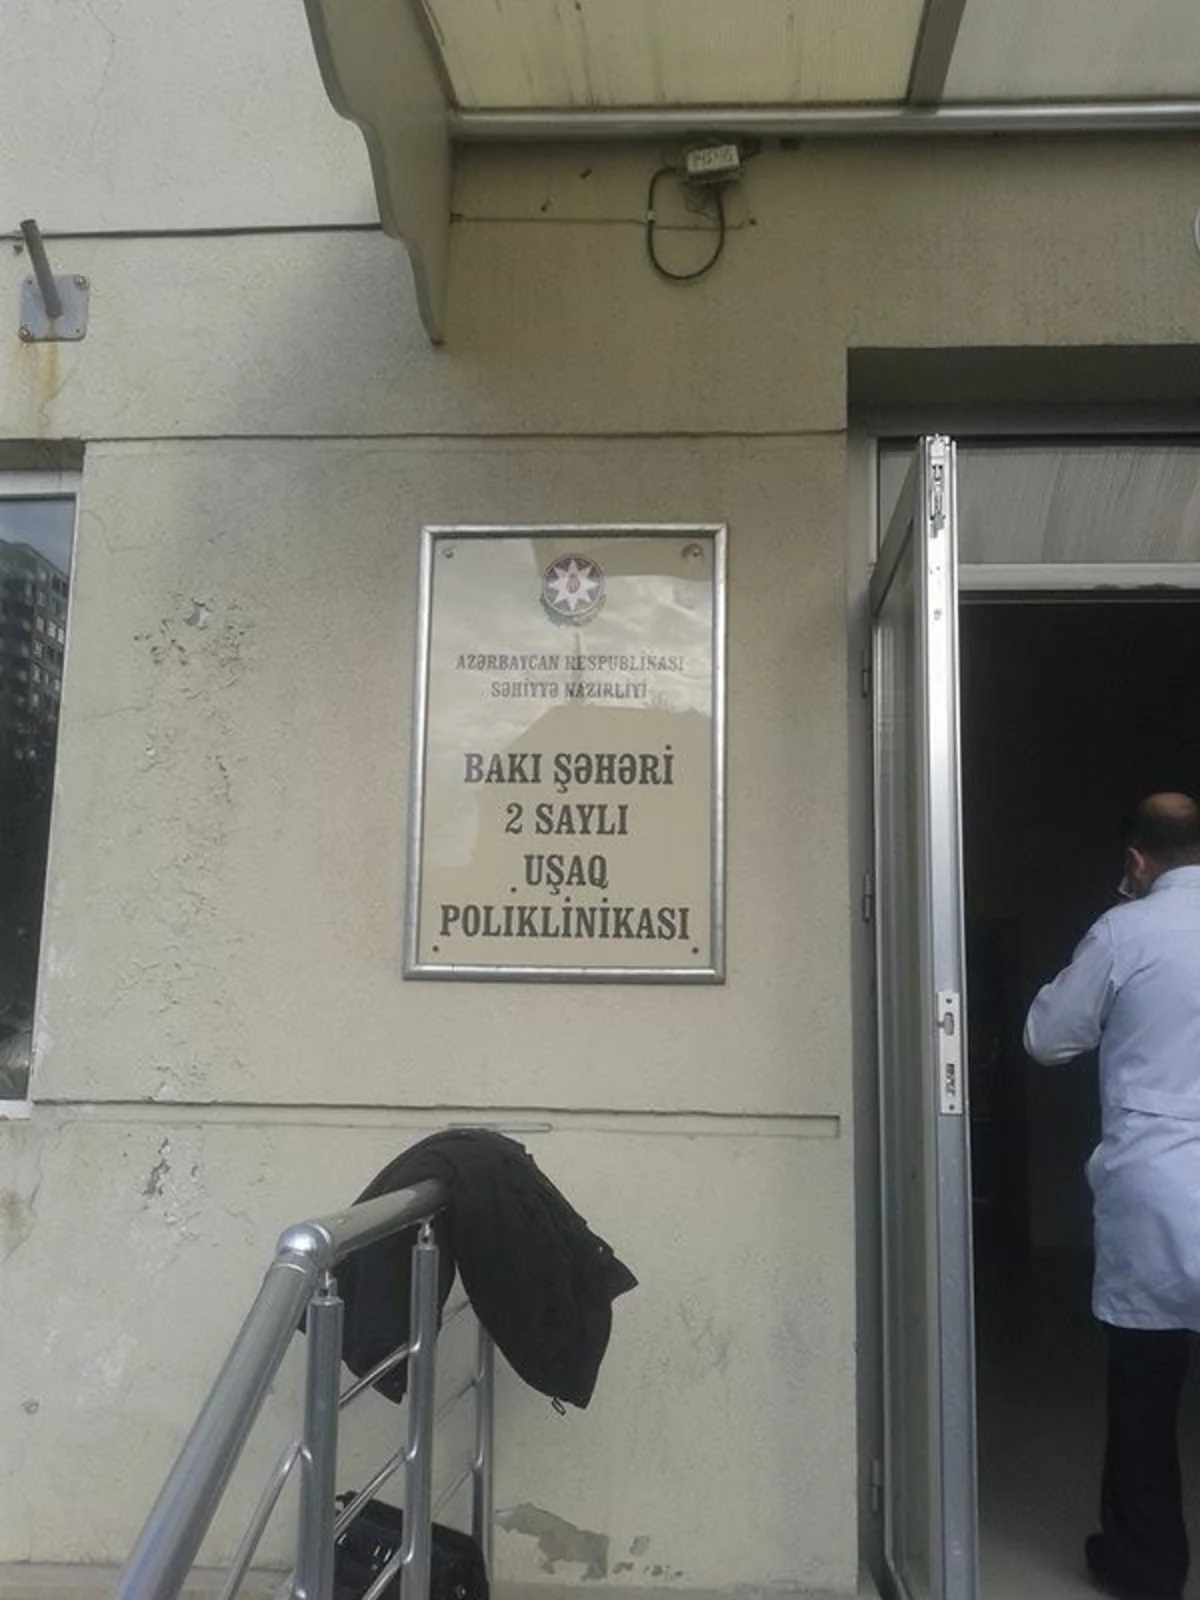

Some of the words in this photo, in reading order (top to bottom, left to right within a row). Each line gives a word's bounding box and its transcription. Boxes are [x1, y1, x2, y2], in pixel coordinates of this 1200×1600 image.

[456, 654, 559, 671] AZƏRBAYCAN
[491, 678, 559, 698] SƏHİYYƏ
[464, 753, 542, 784] BAKI
[553, 744, 675, 794] ŞƏHƏRİ
[505, 802, 523, 834] 2
[535, 803, 629, 835] SAYLI
[524, 854, 609, 895] UŞAQ
